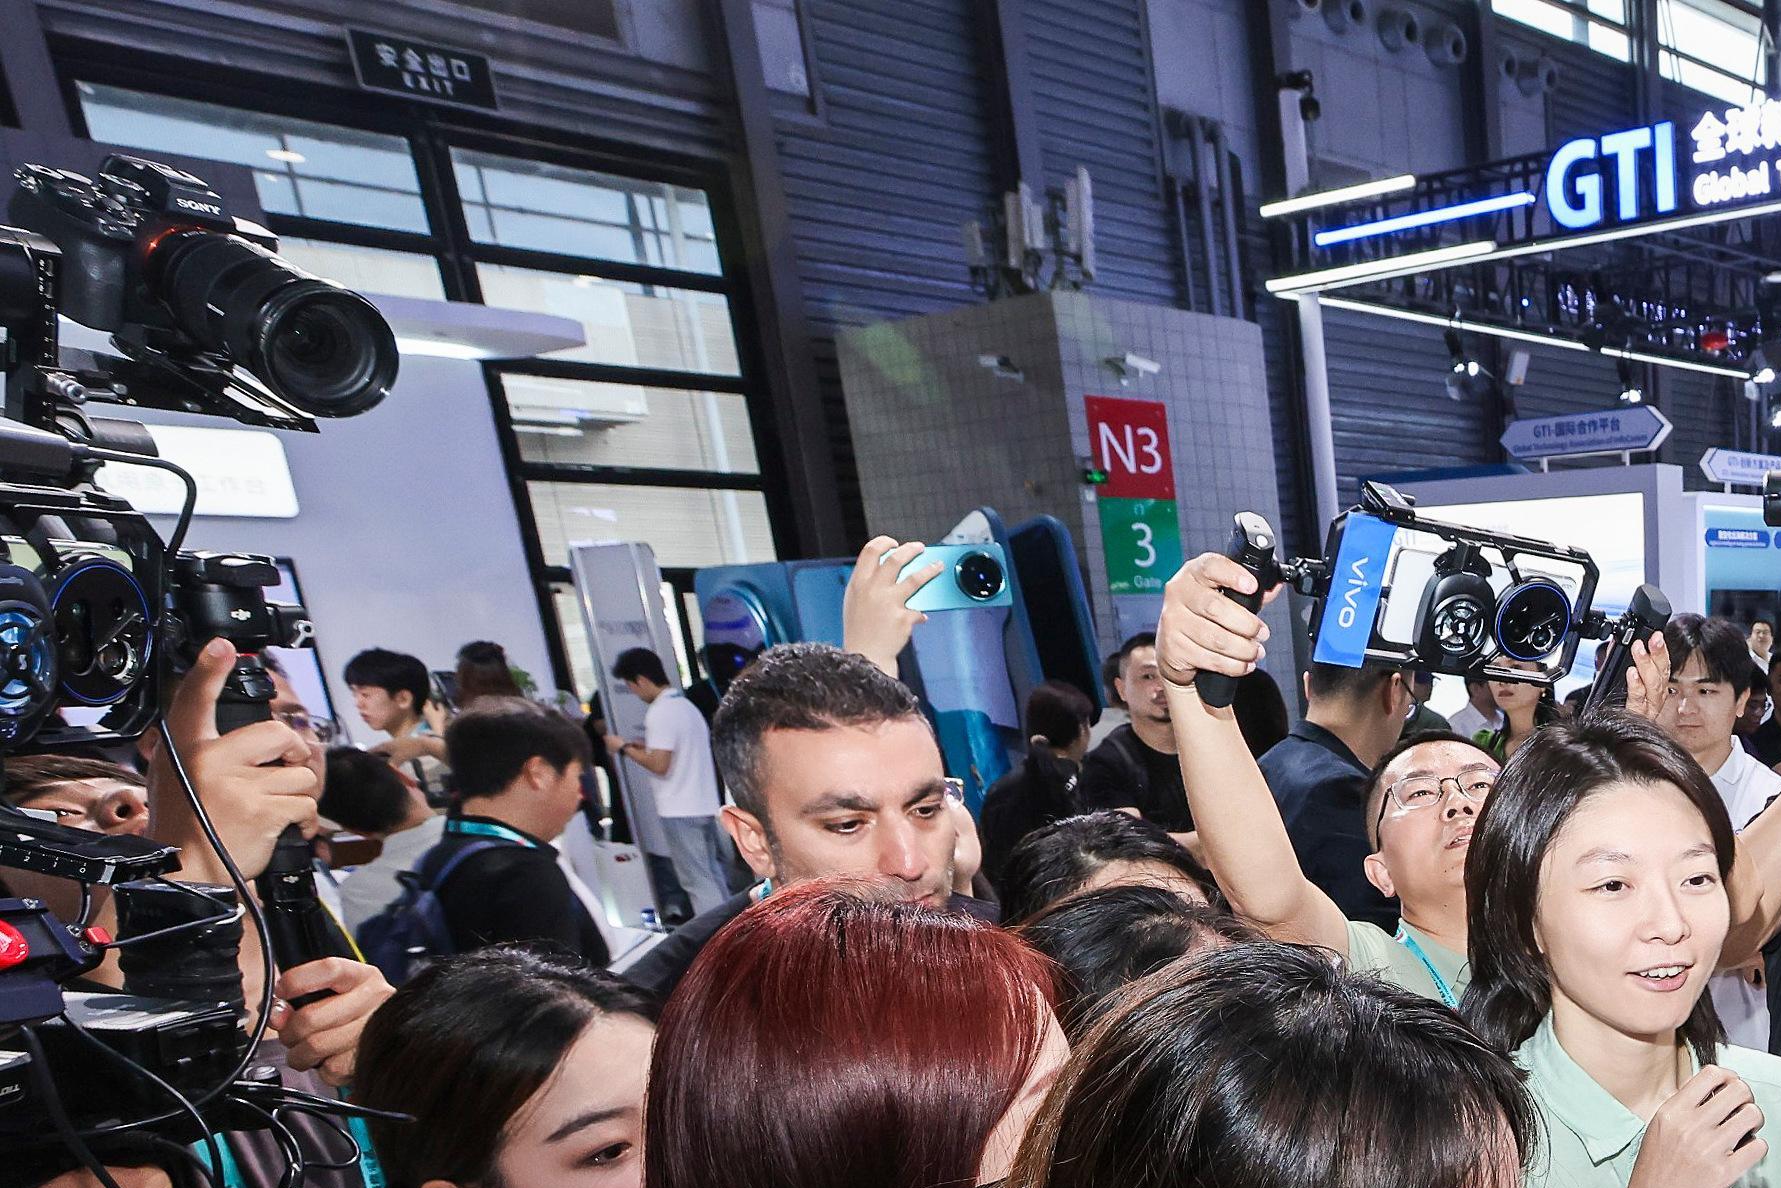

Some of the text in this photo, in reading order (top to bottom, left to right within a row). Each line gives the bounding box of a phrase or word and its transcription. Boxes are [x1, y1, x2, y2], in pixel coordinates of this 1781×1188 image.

[1546, 121, 1676, 231] GTI
[1692, 160, 1770, 205] Global
[176, 197, 222, 216] SONY
[1098, 421, 1162, 475] N3
[1131, 522, 1157, 568] 3
[1338, 556, 1369, 629] vivo
